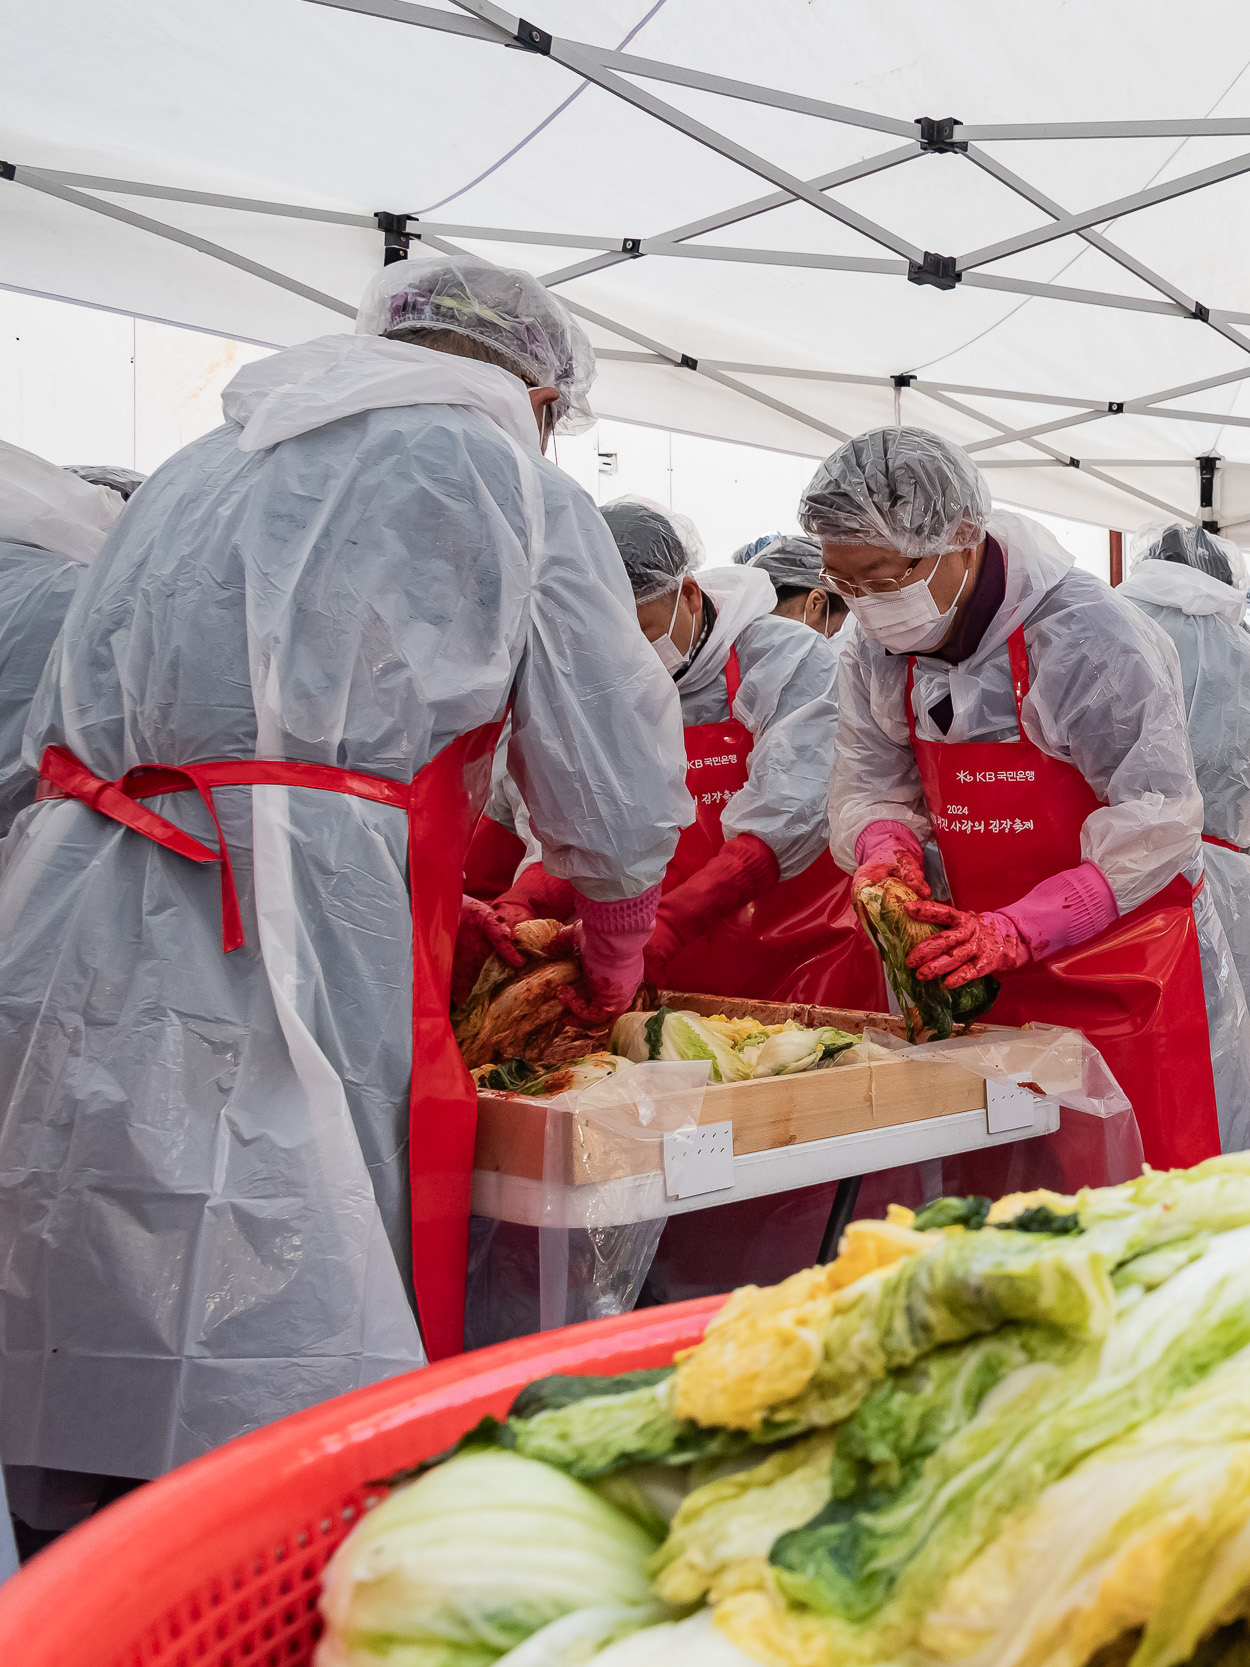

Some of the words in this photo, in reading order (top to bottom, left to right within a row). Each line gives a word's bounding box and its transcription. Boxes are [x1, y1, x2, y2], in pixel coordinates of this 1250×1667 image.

[687, 759, 704, 770] KB
[703, 754, 738, 766] 국민은행
[976, 771, 996, 783] KB
[996, 770, 1036, 782] 국민은행
[946, 804, 969, 816] 2024
[950, 819, 985, 834] 사랑의
[988, 817, 1034, 834] 김장축제
